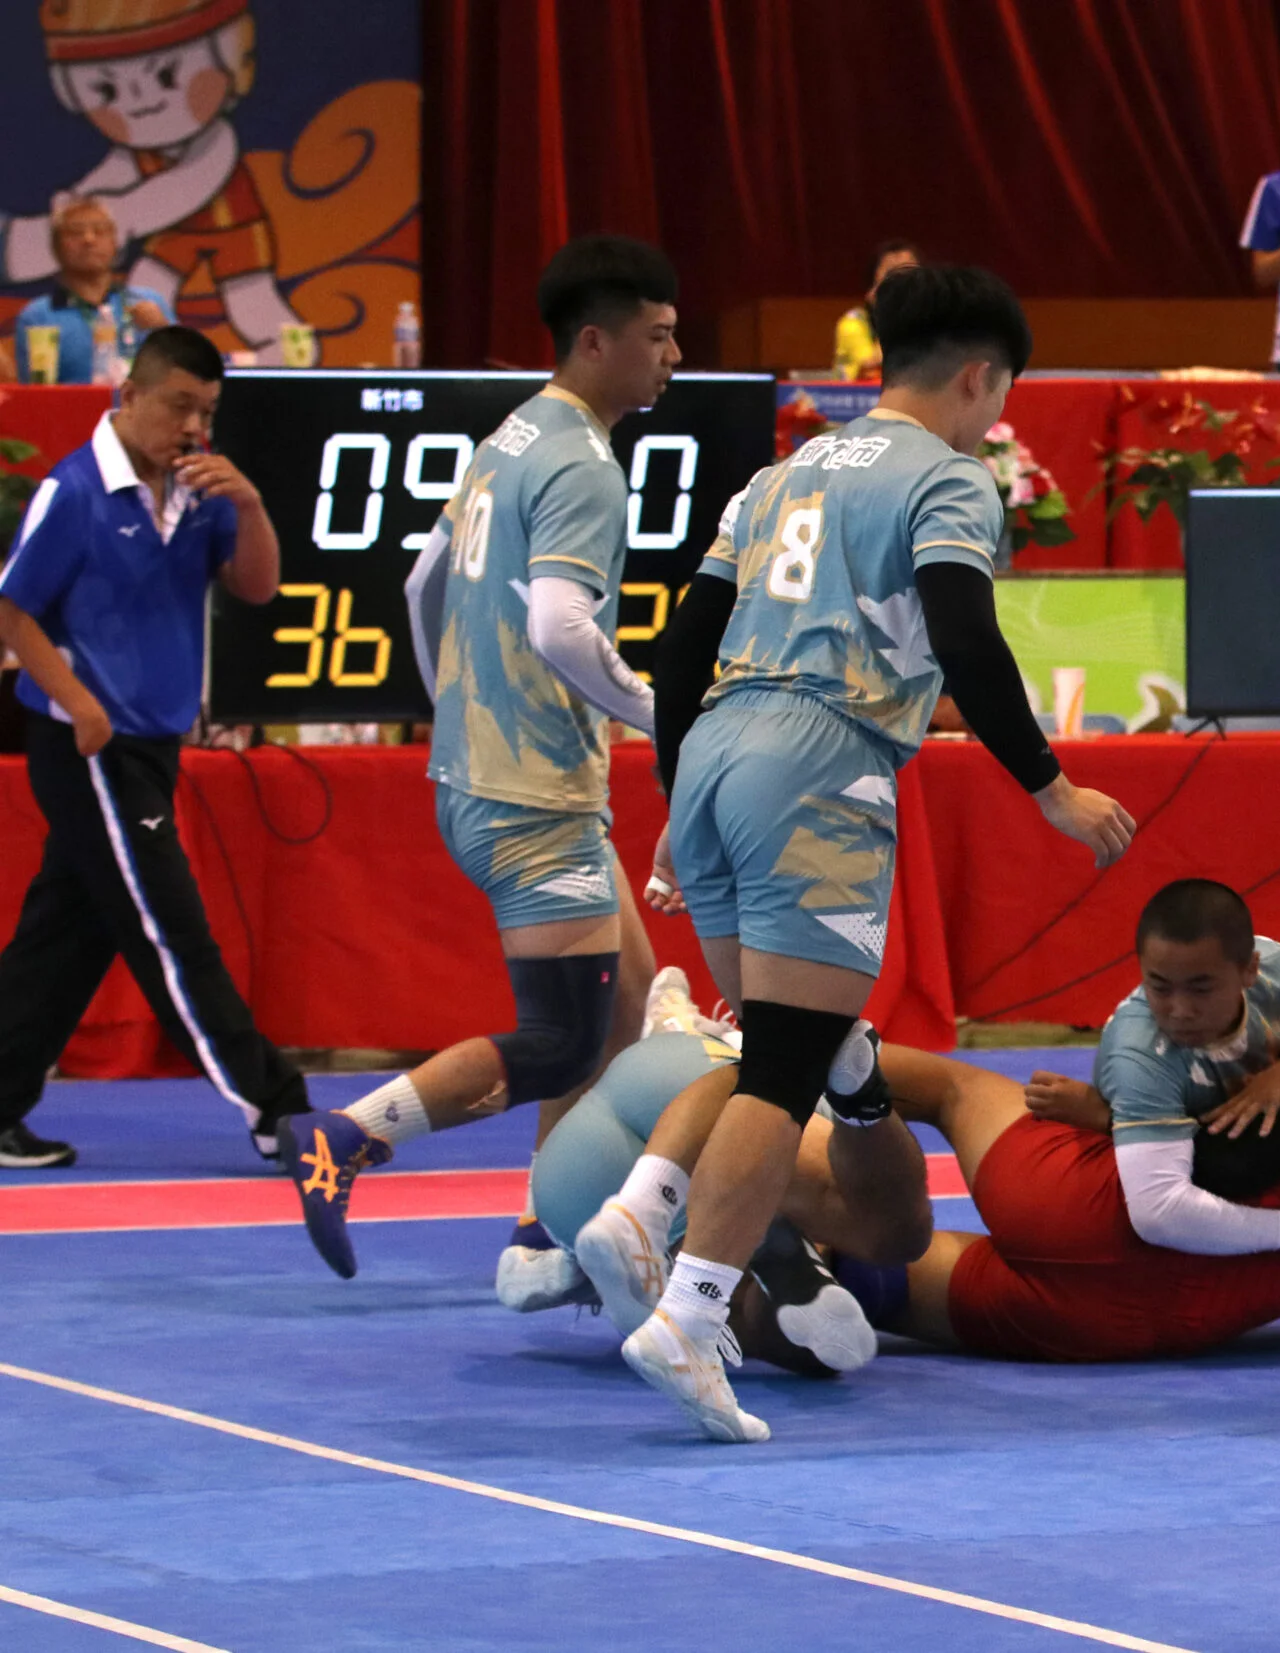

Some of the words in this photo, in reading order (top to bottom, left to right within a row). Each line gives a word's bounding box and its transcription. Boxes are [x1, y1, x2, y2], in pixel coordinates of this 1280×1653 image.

[361, 388, 424, 412] 新竹市
[312, 433, 475, 550] 09
[453, 487, 494, 580] 10
[768, 507, 822, 602] 8
[264, 582, 392, 688] 36
